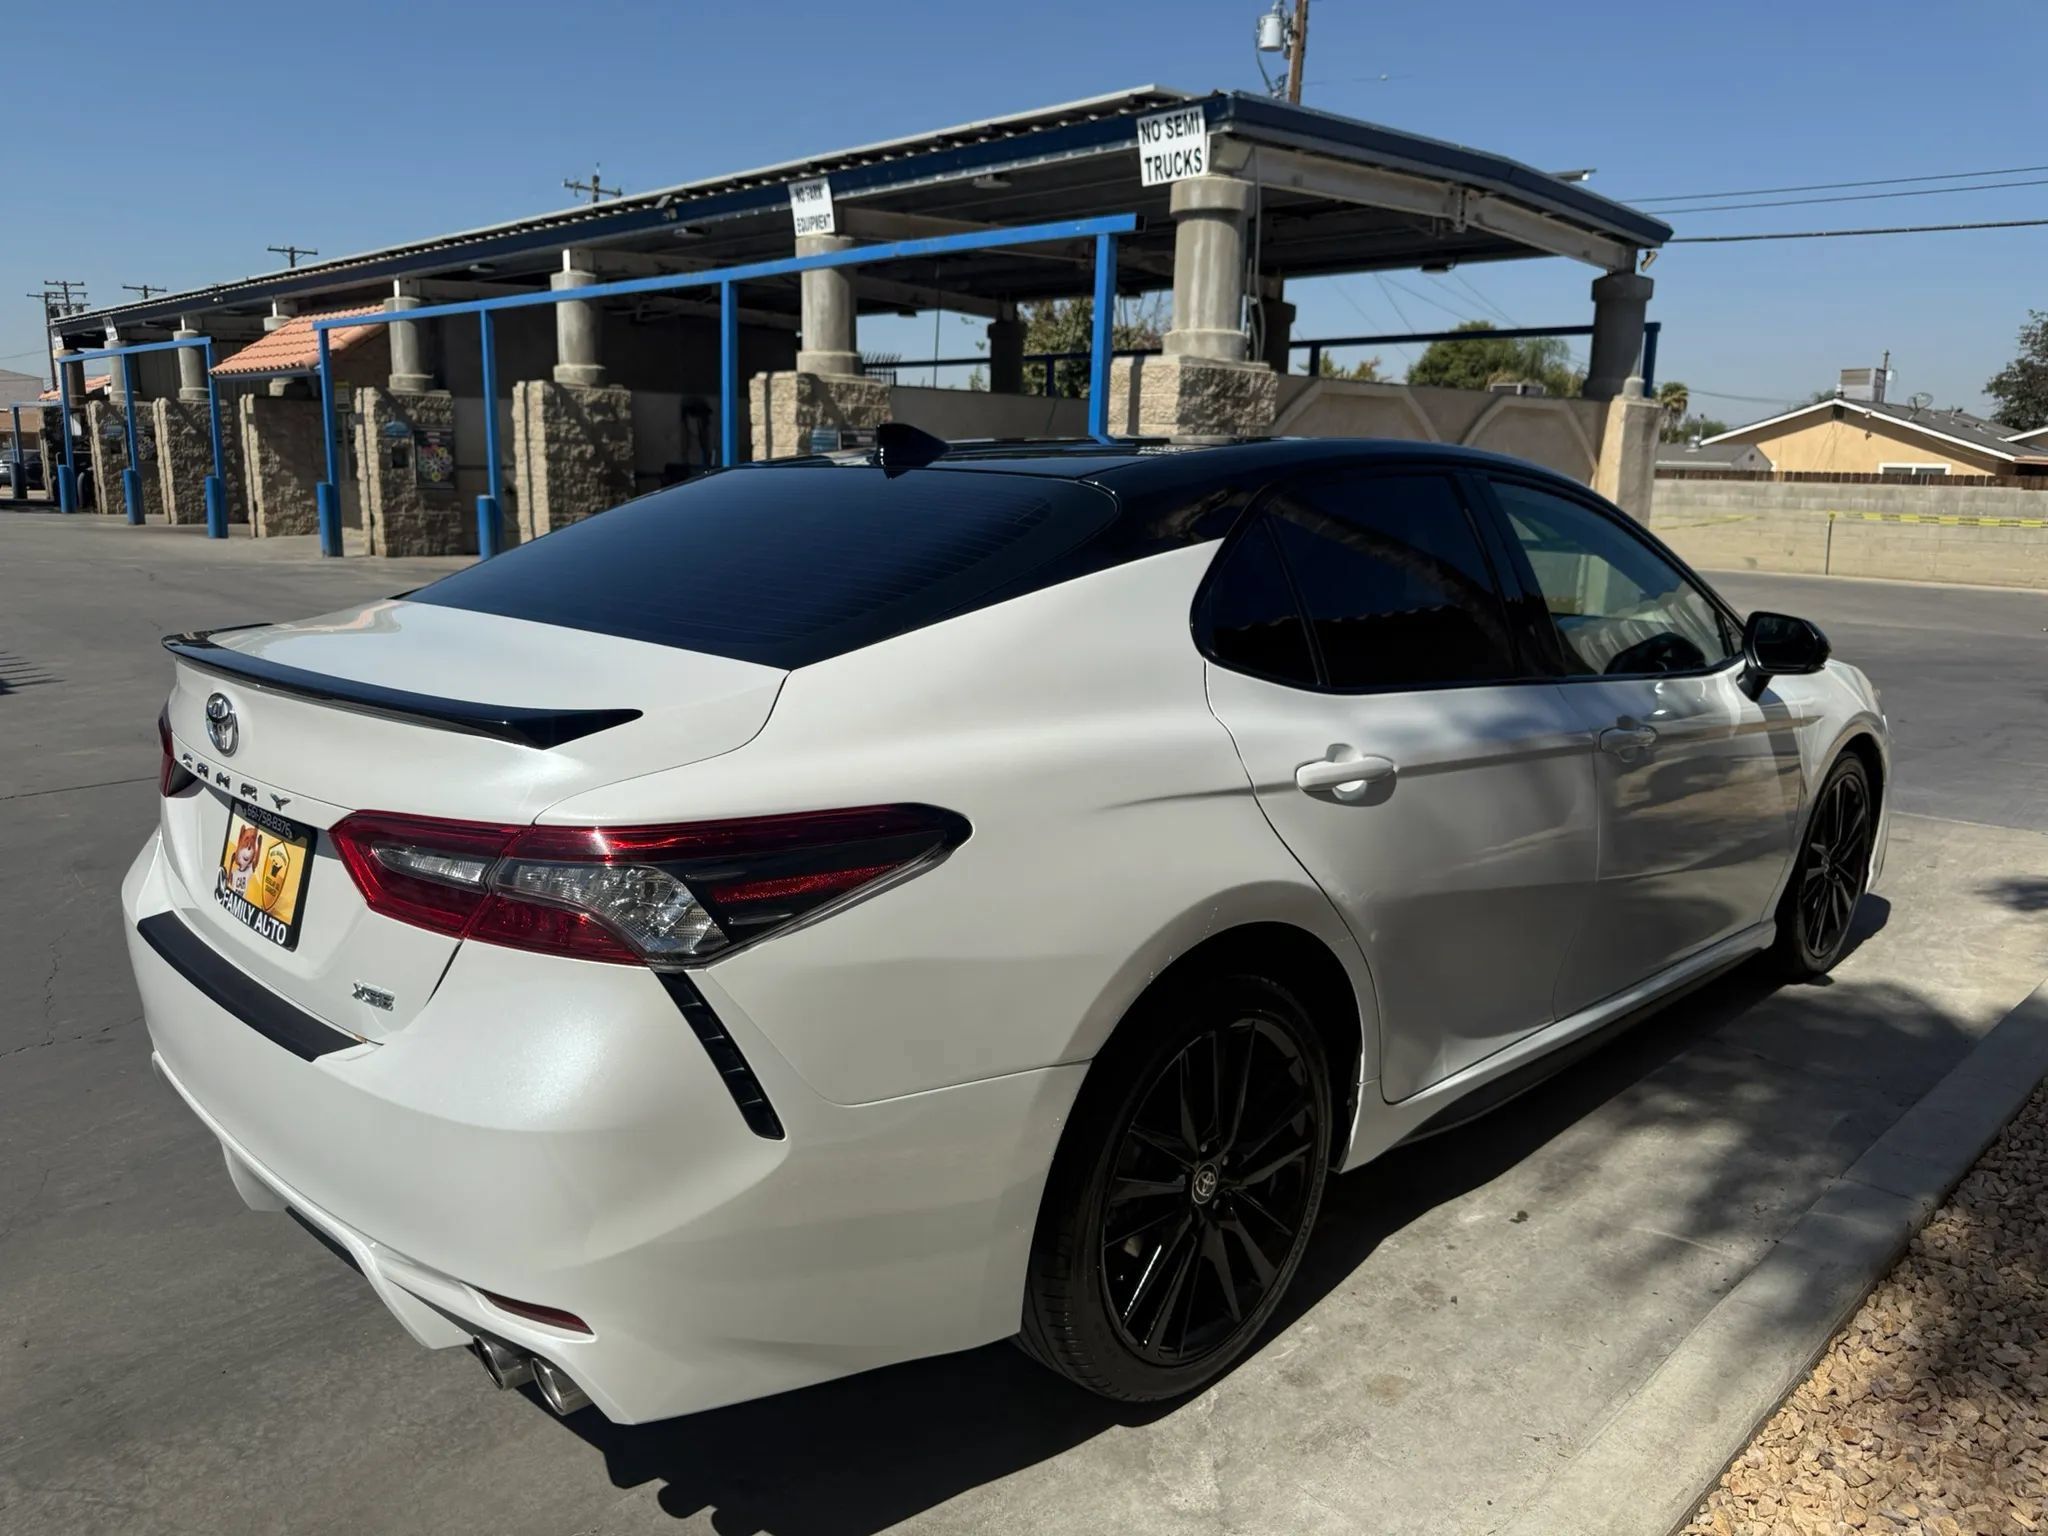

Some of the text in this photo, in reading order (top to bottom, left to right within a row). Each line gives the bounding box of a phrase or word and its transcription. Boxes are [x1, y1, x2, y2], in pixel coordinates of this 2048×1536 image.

[1141, 112, 1200, 144] NO SEMI
[1144, 147, 1202, 182] TRUCKS
[182, 752, 292, 811] CAMRY
[222, 889, 287, 945] FAMILY AUTO
